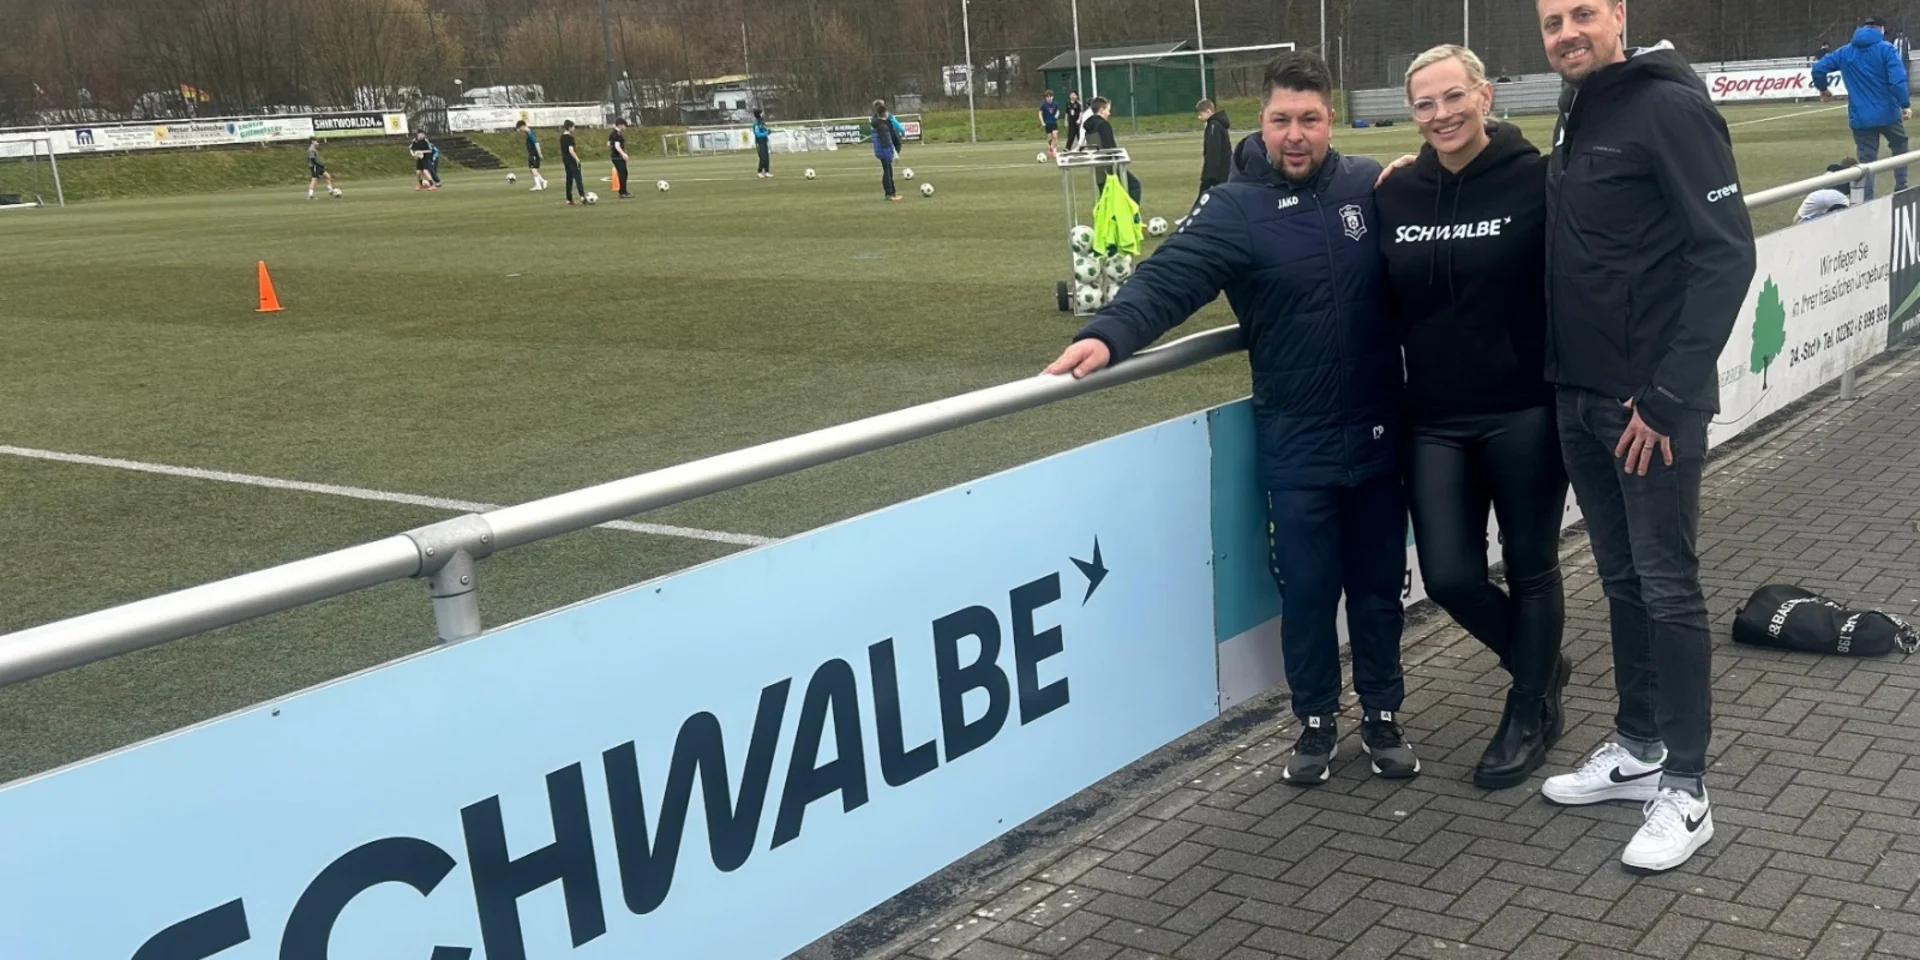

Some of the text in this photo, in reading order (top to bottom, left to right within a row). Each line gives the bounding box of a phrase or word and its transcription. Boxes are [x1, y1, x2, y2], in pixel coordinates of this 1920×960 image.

[1711, 73, 1806, 97] Sportpark
[1278, 196, 1299, 209] JAKO
[1707, 183, 1738, 203] Crew
[1395, 218, 1502, 244] SCHWALBE
[1819, 241, 1869, 277] Wir pflegen Sie
[1792, 298, 1800, 317] in
